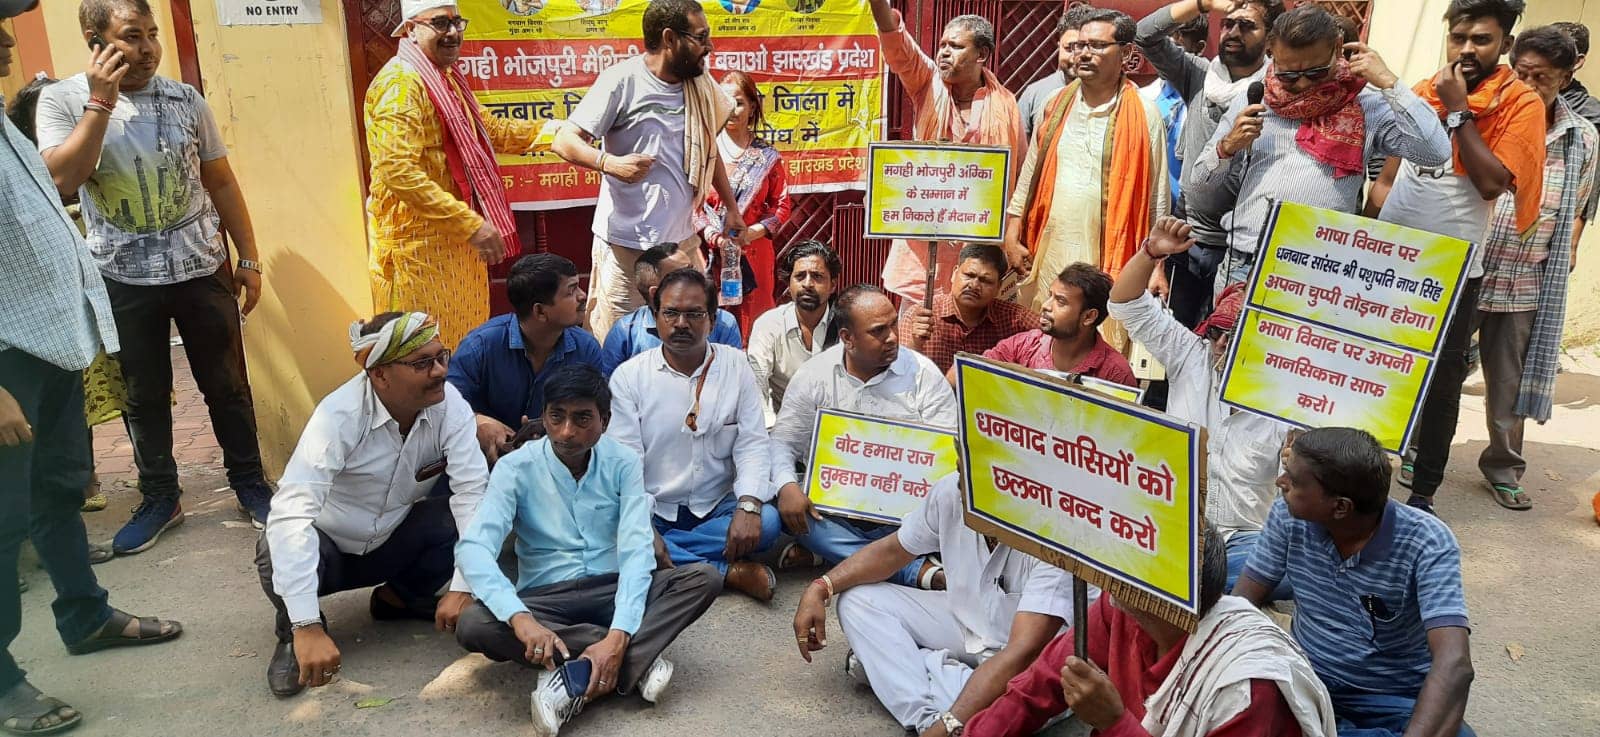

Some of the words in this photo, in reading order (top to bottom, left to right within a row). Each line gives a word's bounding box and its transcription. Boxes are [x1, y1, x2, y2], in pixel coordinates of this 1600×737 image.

[246, 6, 262, 15] NO
[266, 6, 298, 15] ENTRY
[458, 46, 498, 80] गही
[504, 45, 578, 87] भोजपुरी
[714, 44, 768, 72] बचाओ
[772, 42, 833, 74] झारखंड
[838, 42, 876, 73] प्रदेश
[483, 101, 555, 121] नबाद
[773, 85, 829, 112] जिला
[836, 84, 856, 110] में
[754, 122, 794, 145] रोध
[800, 121, 820, 143] में
[538, 166, 578, 188] मगही
[838, 152, 866, 173] प्रदेश
[884, 162, 914, 178] मगही
[916, 163, 955, 183] भोजपुरी
[906, 186, 918, 199] के
[920, 188, 955, 200] सम्मान
[958, 187, 970, 201] में
[883, 210, 899, 222] हम
[902, 207, 934, 223] निकले
[948, 209, 976, 223] मैदान
[978, 211, 991, 224] में
[1315, 226, 1351, 247] भाषा
[1352, 229, 1396, 258] विवाद
[1398, 245, 1422, 264] पर
[1311, 253, 1342, 276] सांसद
[1343, 258, 1359, 280] श्री
[1359, 267, 1396, 291] पशुपति
[1396, 277, 1420, 295] नाथ
[1420, 278, 1444, 302] सिंह
[1264, 274, 1306, 297] अपना
[1308, 283, 1343, 308] चुप्पी
[1343, 293, 1388, 319] तोड़ना
[1258, 319, 1293, 340] भाषा
[1295, 325, 1340, 354] विवाद
[1343, 342, 1366, 362] पर
[1365, 350, 1415, 375] अपनी
[1350, 375, 1387, 398] साफ
[835, 433, 861, 455] वोट
[863, 441, 905, 461] हमारा
[907, 448, 936, 467] राज
[975, 411, 1047, 456] धनबाद
[1052, 435, 1134, 486] वासियों
[1137, 464, 1174, 502] को
[820, 465, 868, 490] तुम्हारा
[871, 472, 902, 494] नहीं
[902, 478, 932, 498] चले
[992, 465, 1053, 508] छलना
[1058, 491, 1103, 529] बन्द
[1109, 510, 1157, 551] करो
